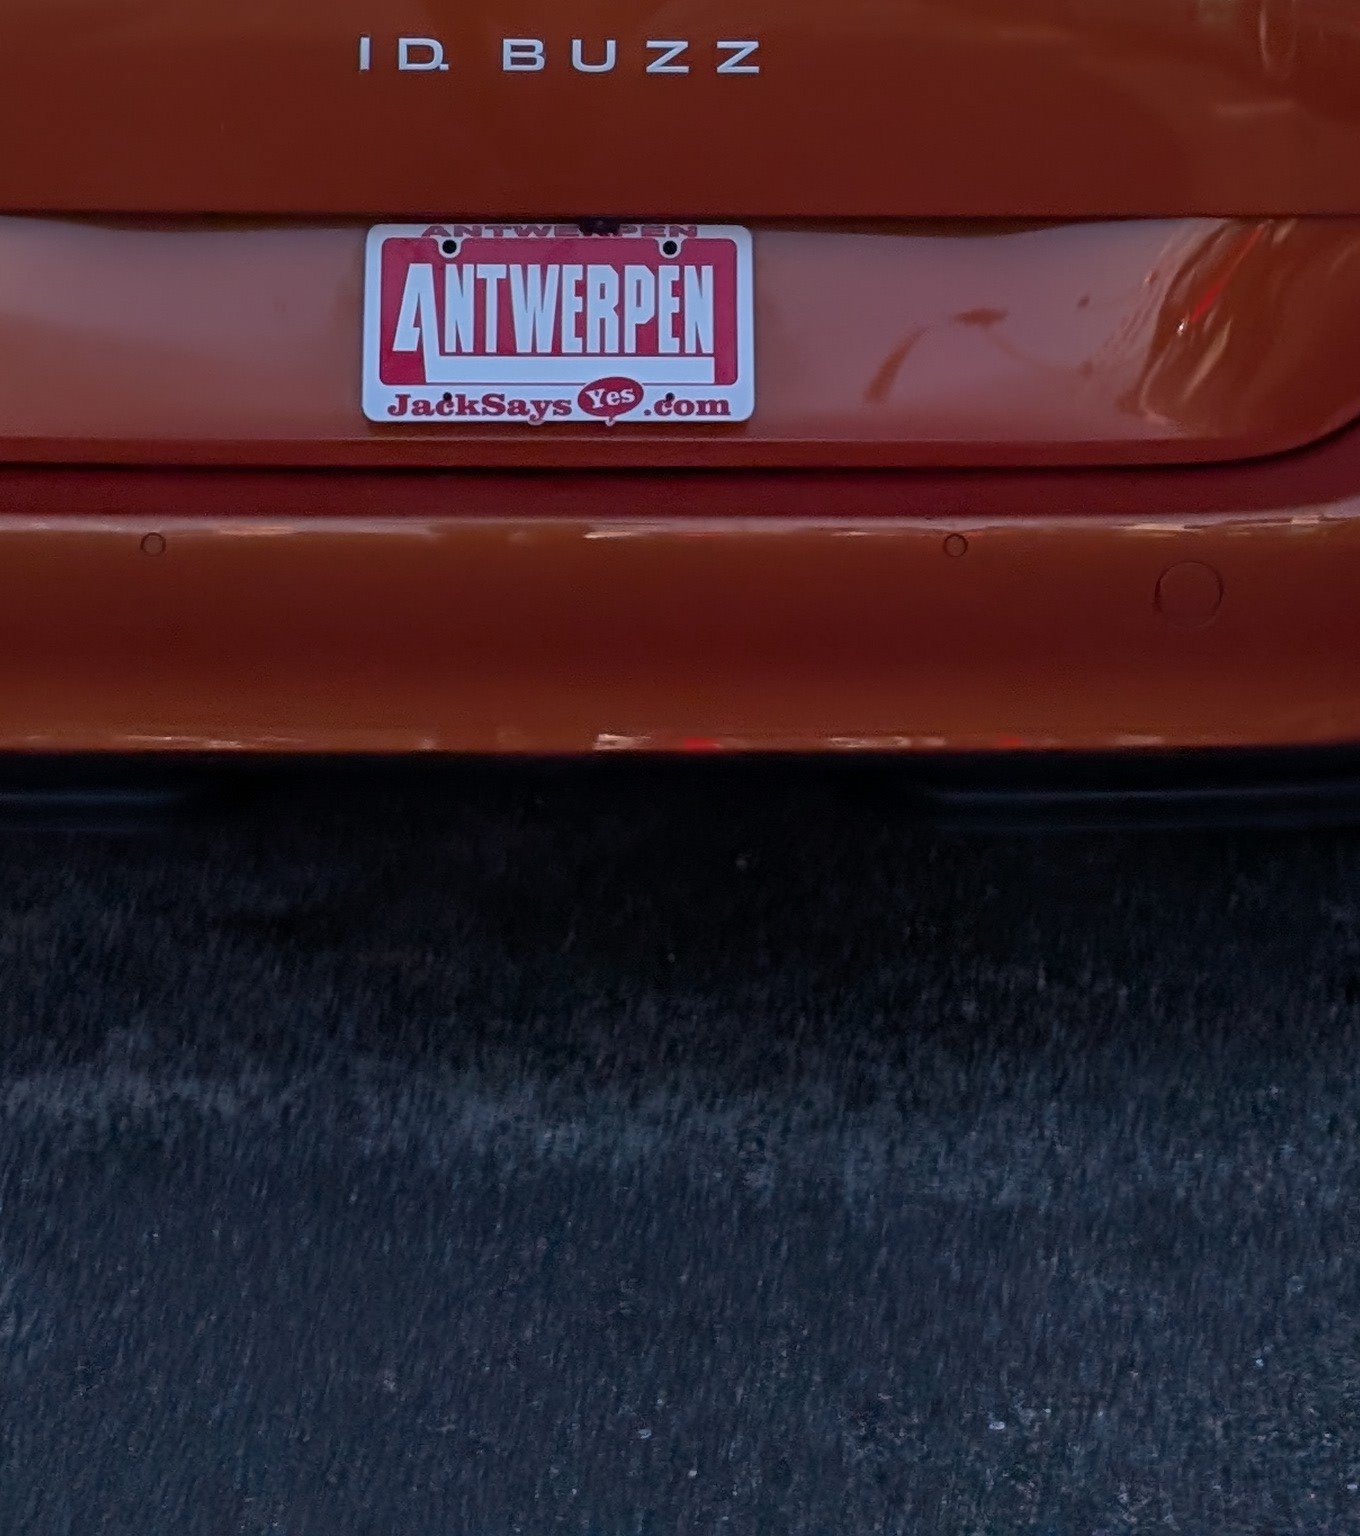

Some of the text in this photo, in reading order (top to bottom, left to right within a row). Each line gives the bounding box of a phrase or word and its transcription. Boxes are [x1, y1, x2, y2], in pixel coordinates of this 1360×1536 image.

[503, 38, 760, 74] BUZZ
[421, 224, 698, 238] ANTWEPEN
[392, 263, 715, 376] ANTWERPEN
[585, 387, 637, 410] Yes
